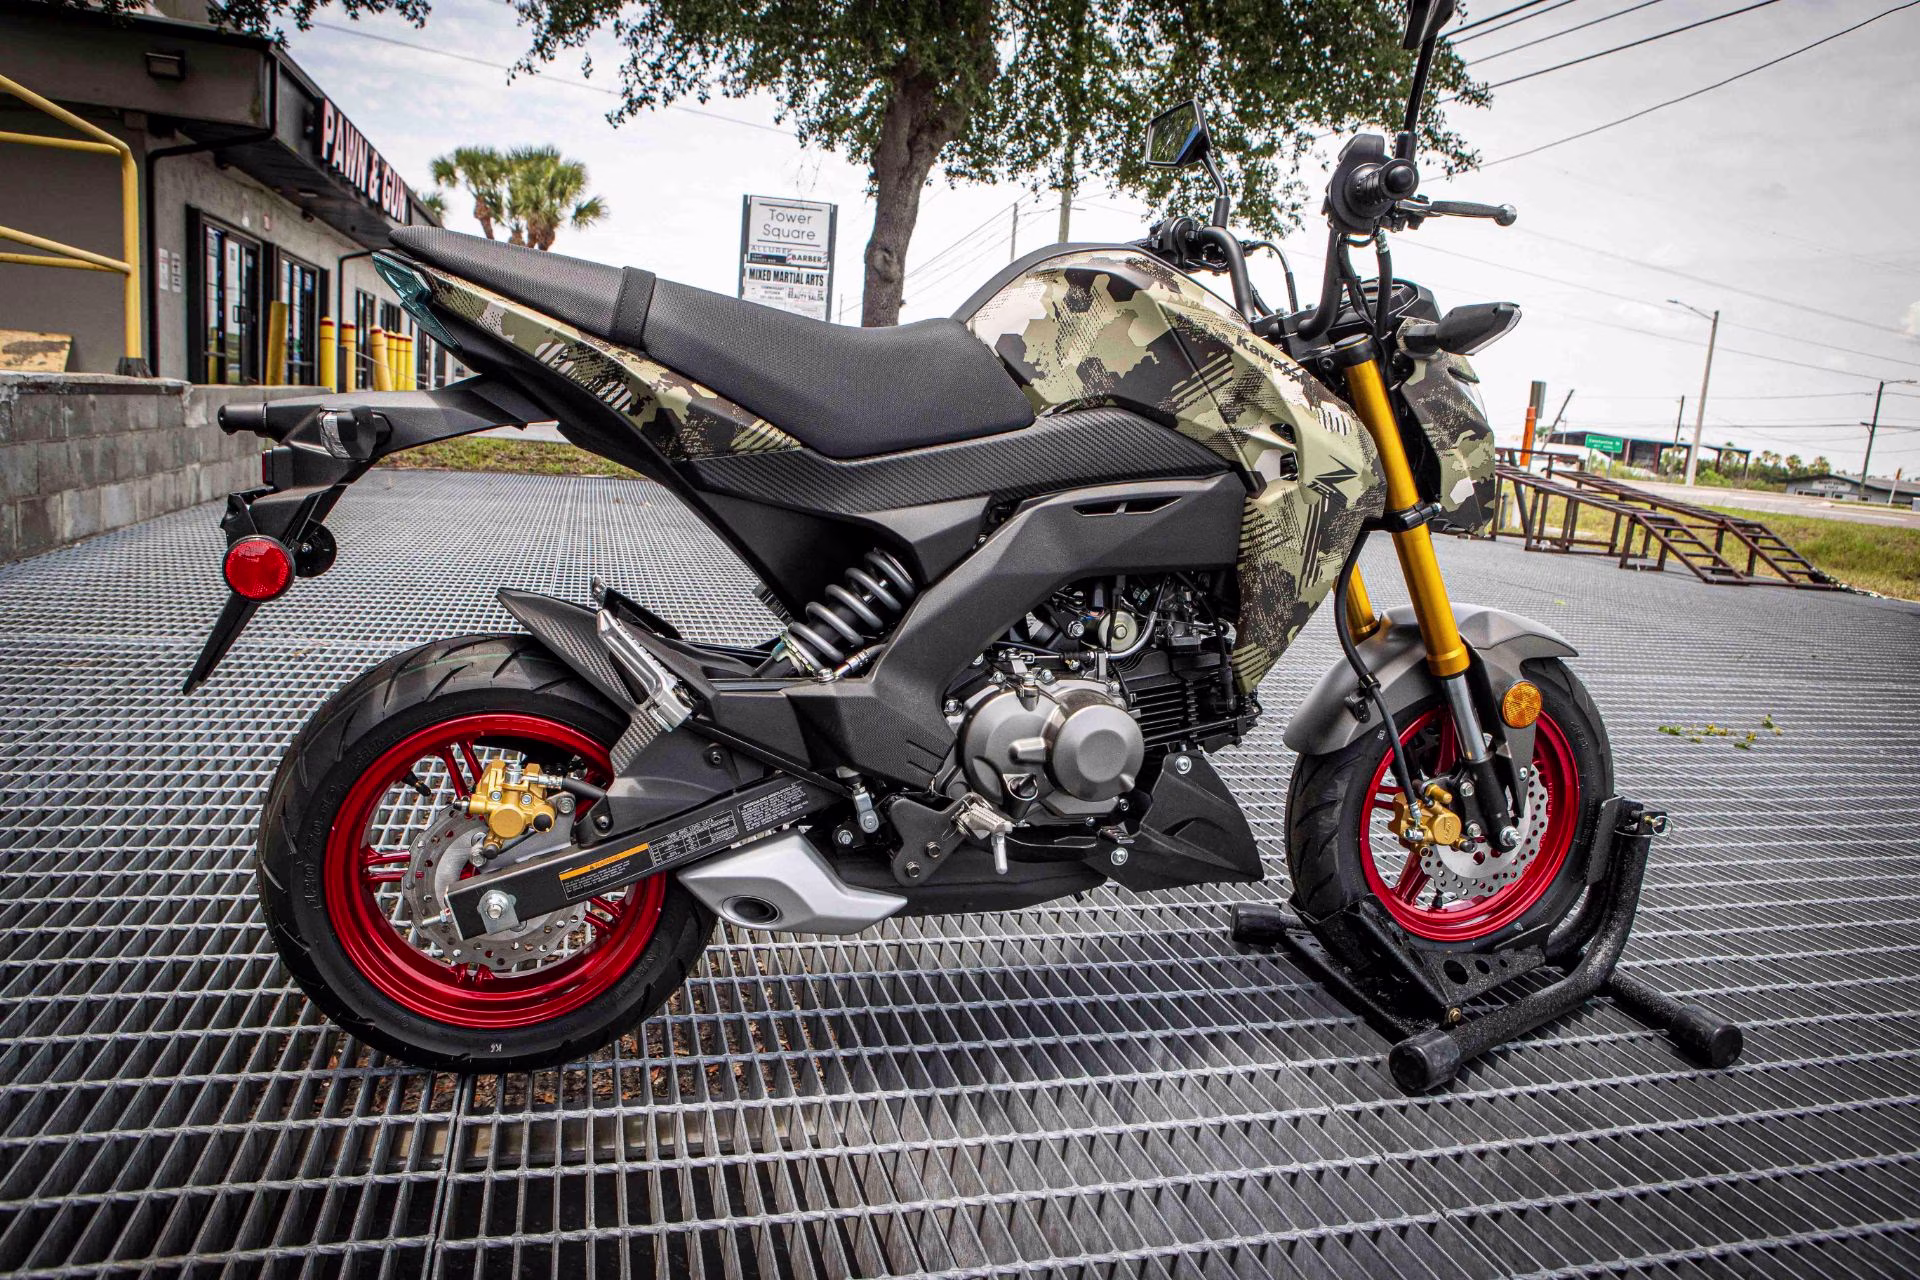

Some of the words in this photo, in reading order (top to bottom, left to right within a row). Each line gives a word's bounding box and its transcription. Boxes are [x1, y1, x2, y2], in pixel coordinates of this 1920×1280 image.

[322, 97, 369, 194] PAWN
[368, 150, 380, 204] &
[382, 162, 406, 225] GUN
[769, 208, 812, 225] Tower
[763, 223, 816, 241] Square
[791, 253, 822, 263] BARBER
[748, 268, 772, 282] MIXED
[773, 270, 804, 285] MARTIAL
[805, 273, 824, 287] ARTS
